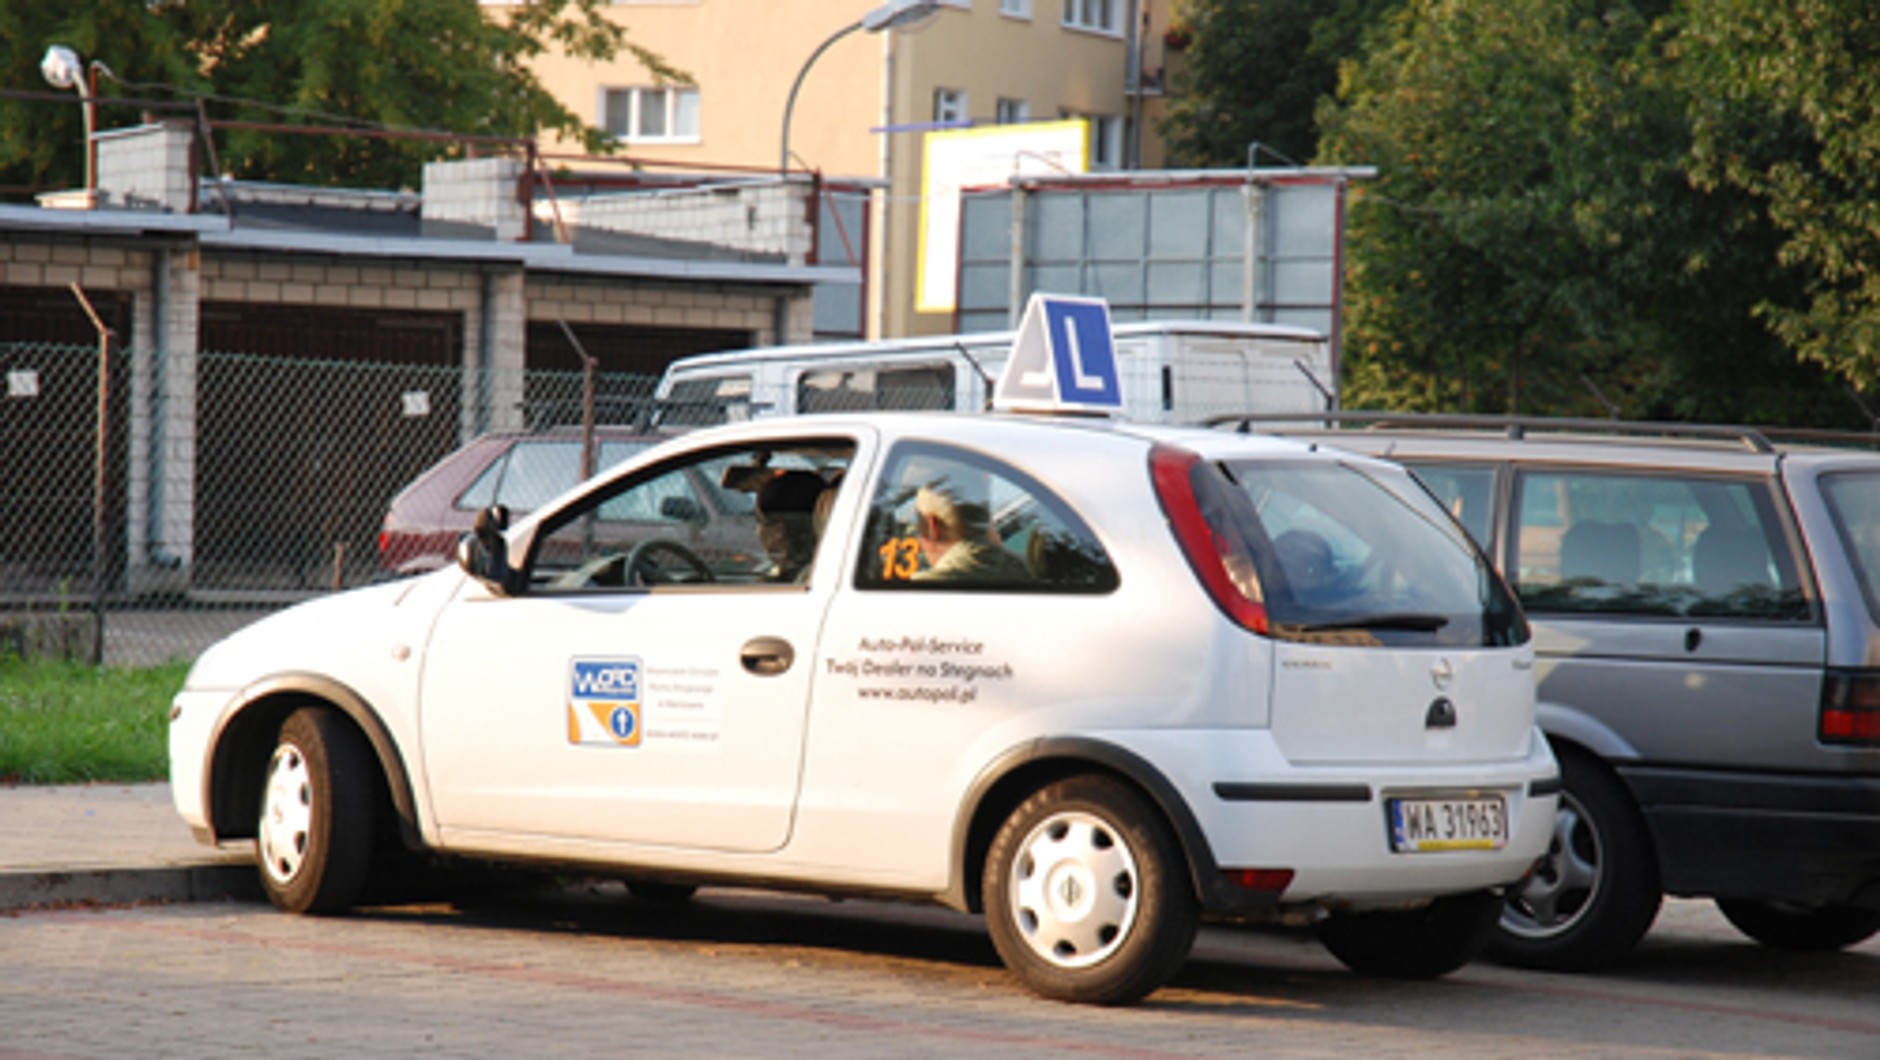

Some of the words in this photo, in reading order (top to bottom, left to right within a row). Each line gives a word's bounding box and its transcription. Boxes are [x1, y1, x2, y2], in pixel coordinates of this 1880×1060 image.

[1064, 316, 1104, 390] L
[880, 537, 919, 579] 13
[861, 659, 912, 677] Dealer
[917, 664, 937, 677] na
[1405, 803, 1438, 839] WA
[1443, 803, 1502, 838] 31963
